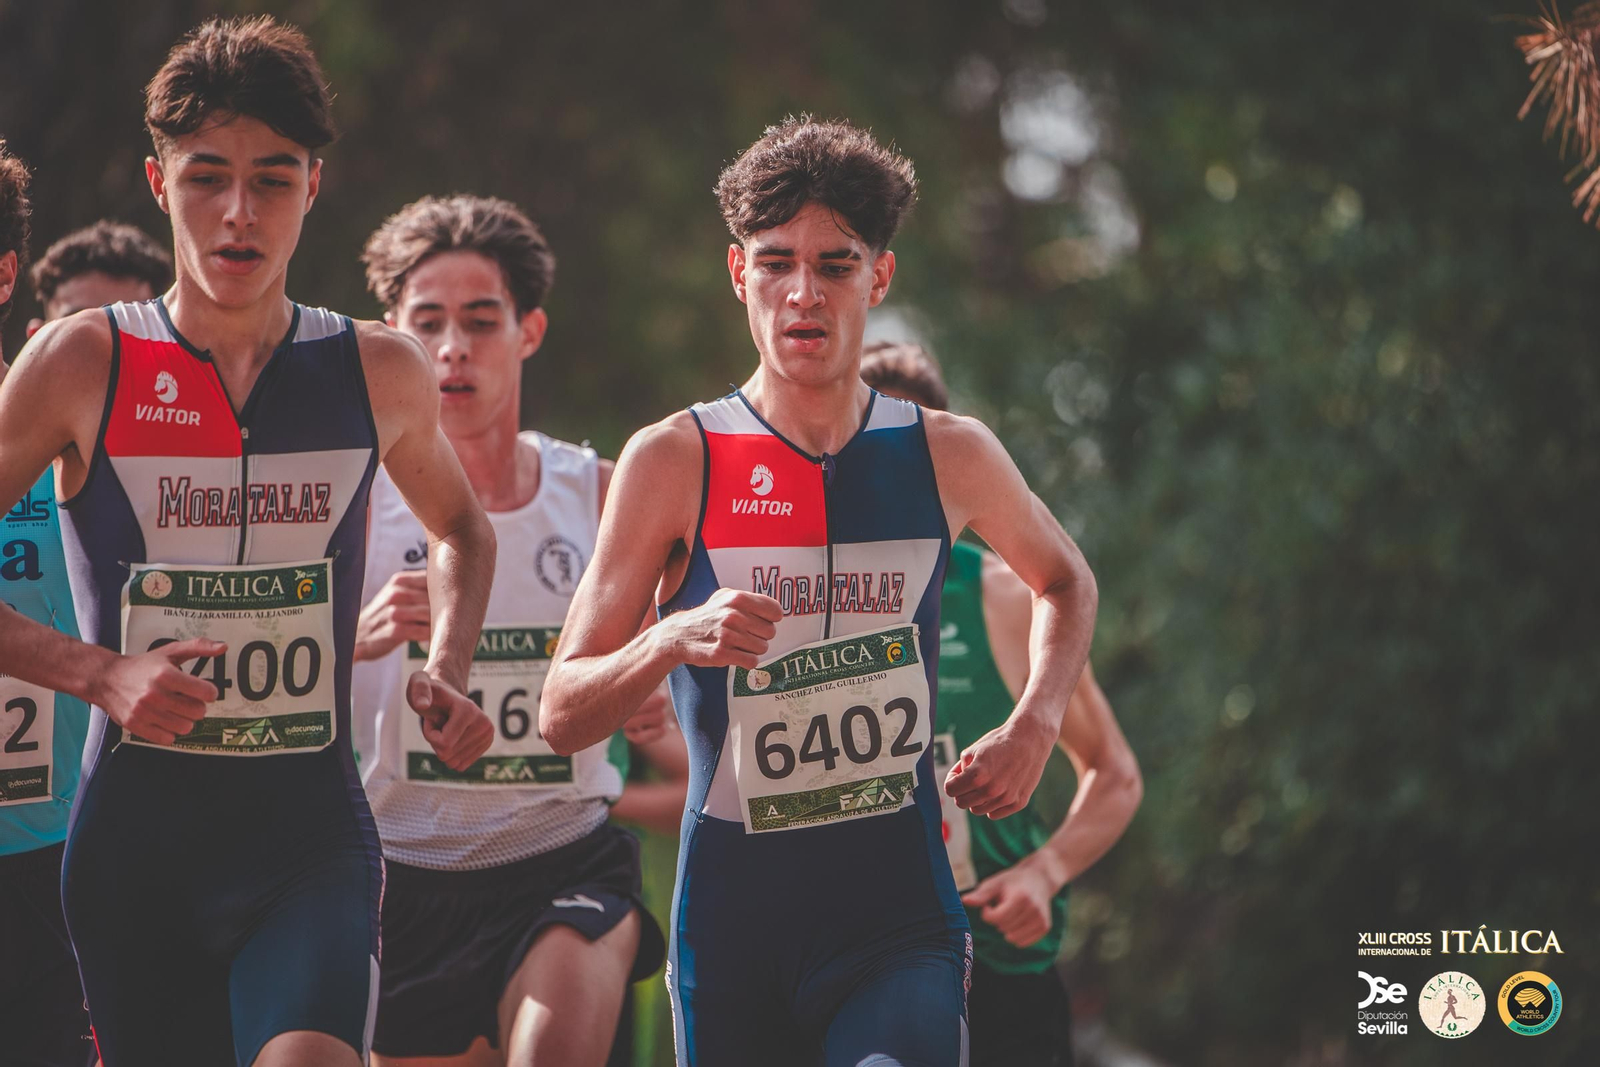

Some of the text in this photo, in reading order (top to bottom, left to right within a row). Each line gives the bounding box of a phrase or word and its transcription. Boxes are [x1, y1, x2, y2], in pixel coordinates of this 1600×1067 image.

[135, 404, 201, 426] VIATOR
[732, 498, 794, 516] VIATOR
[187, 573, 285, 597] ITÁLICA
[255, 607, 304, 619] ALEJANDRO
[476, 629, 536, 651] ÁLICA
[146, 637, 321, 702] 400
[782, 643, 874, 679] ITÁLICA
[848, 661, 875, 671] COUNTRY
[775, 672, 887, 702] SÁNCHEZ RUIZ, GUILLERMO
[755, 697, 923, 780] 6402
[788, 816, 825, 828] FEDERACIÓN
[827, 810, 860, 823] ANDALUZA
